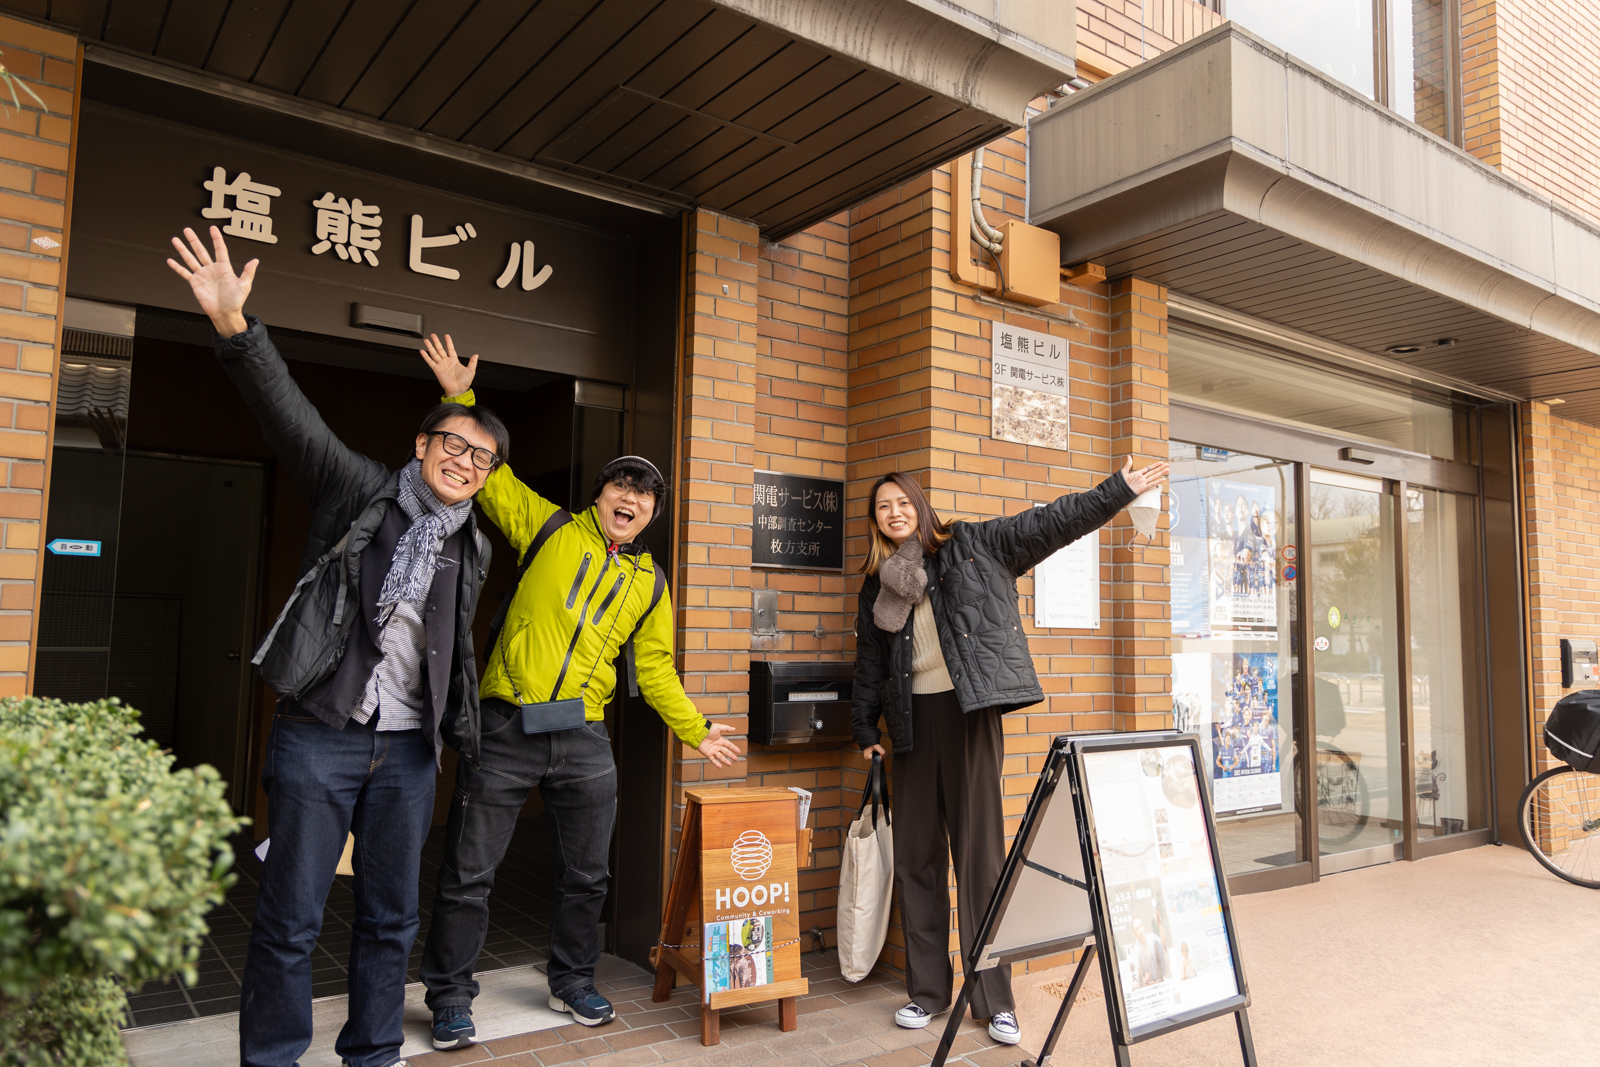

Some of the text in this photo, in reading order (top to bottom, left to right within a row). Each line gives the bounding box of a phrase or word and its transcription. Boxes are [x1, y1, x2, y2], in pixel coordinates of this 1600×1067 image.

[201, 166, 553, 291] 塩熊ビル
[1000, 331, 1061, 360] 塩熊ビル
[994, 362, 1007, 375] 3F
[758, 514, 832, 533] 中部調査センター
[770, 538, 820, 557] 枚方支所
[1343, 612, 1371, 624] Agio
[715, 882, 790, 910] HOOP!
[716, 912, 751, 921] Community
[758, 908, 790, 917] Coworking
